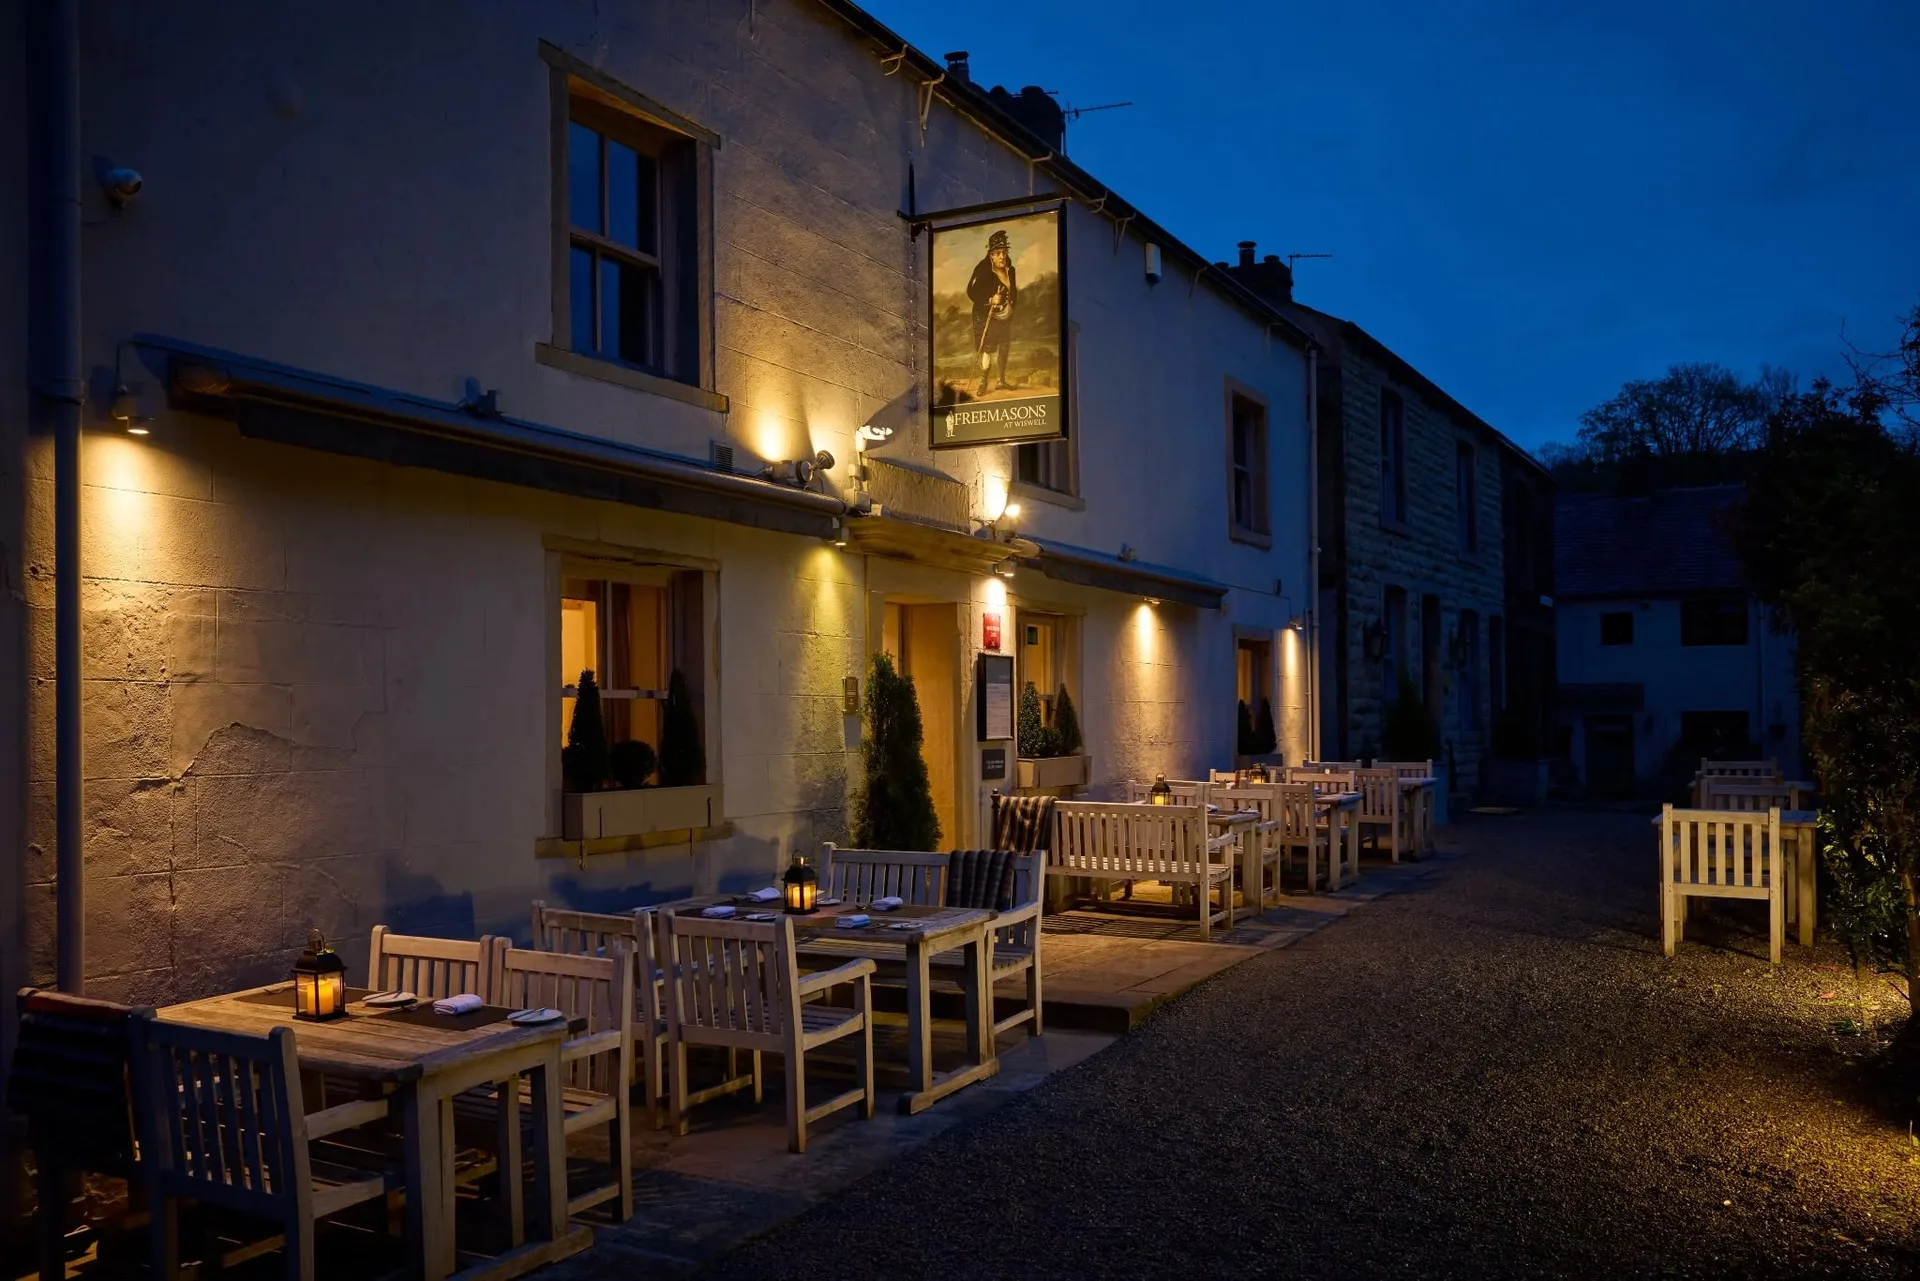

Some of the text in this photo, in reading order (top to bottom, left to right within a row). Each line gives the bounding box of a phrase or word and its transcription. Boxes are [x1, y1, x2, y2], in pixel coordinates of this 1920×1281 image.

[954, 404, 1046, 426] FREEMASONS
[1003, 418, 1047, 429] AT WISWELL
